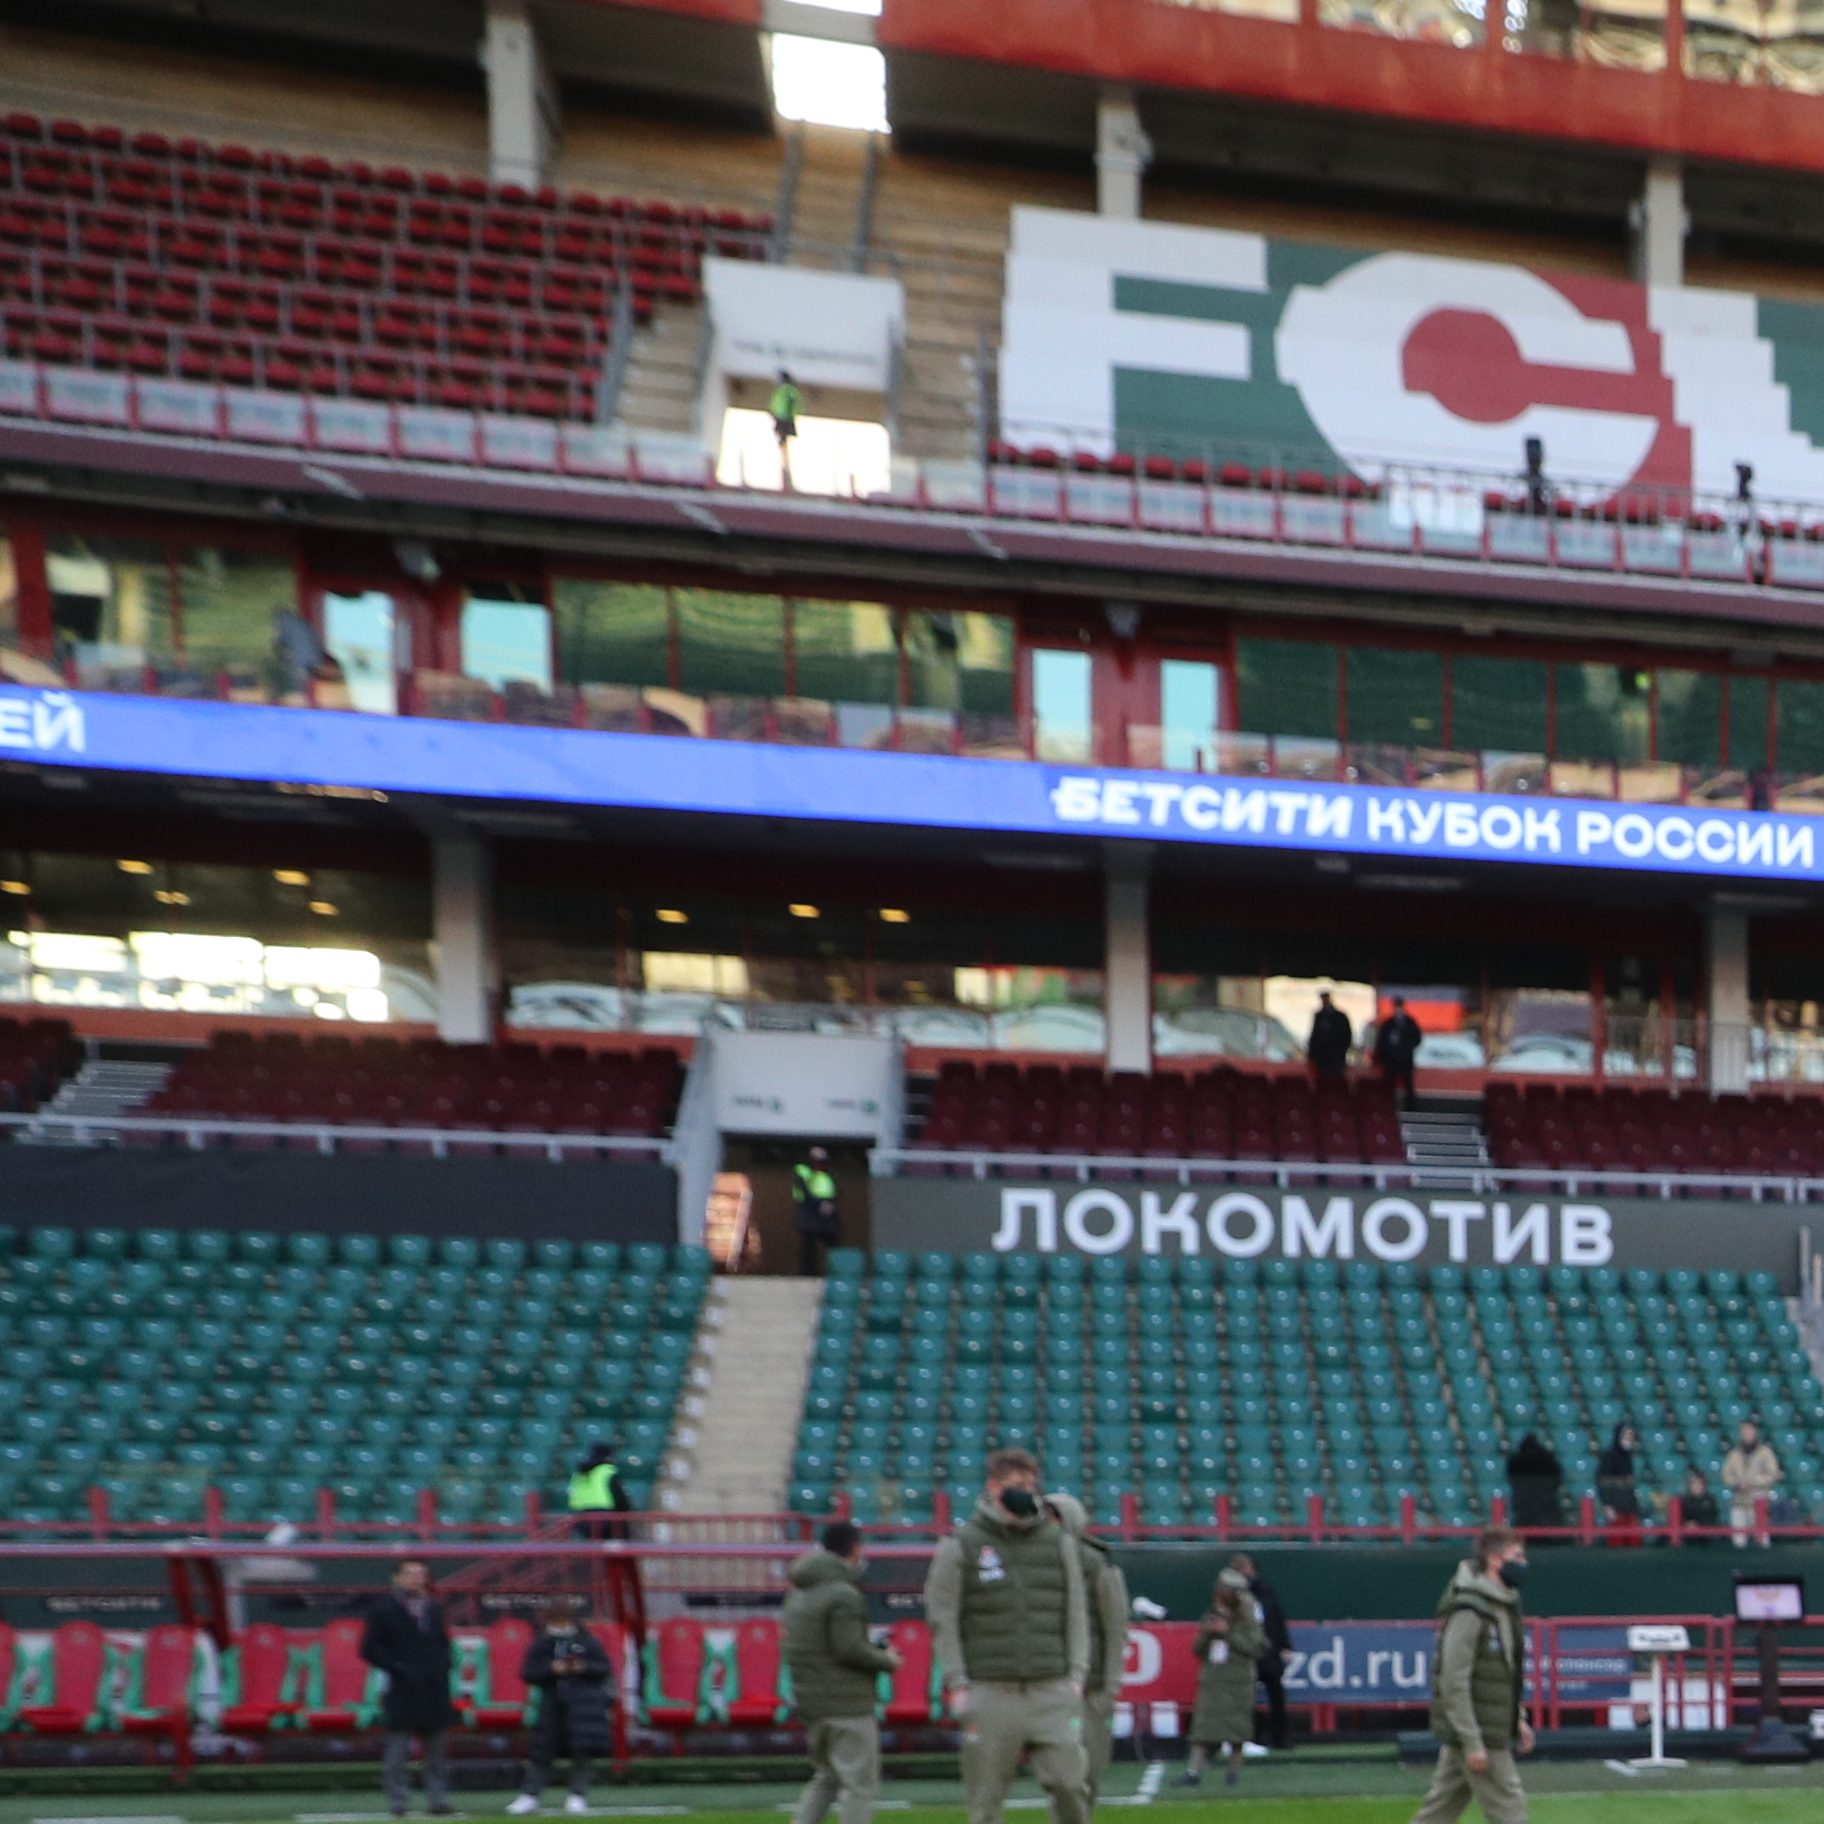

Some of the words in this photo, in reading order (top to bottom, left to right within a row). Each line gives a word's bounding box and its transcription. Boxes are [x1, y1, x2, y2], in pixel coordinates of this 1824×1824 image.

[1050, 775, 1352, 840] БЕТСИТИ
[1366, 797, 1562, 852] КУБОК
[1576, 810, 1814, 869] РОССИИ
[992, 1186, 1615, 1266] ЛОКОМОТИВ
[1281, 1635, 1427, 1688] zd.ru
